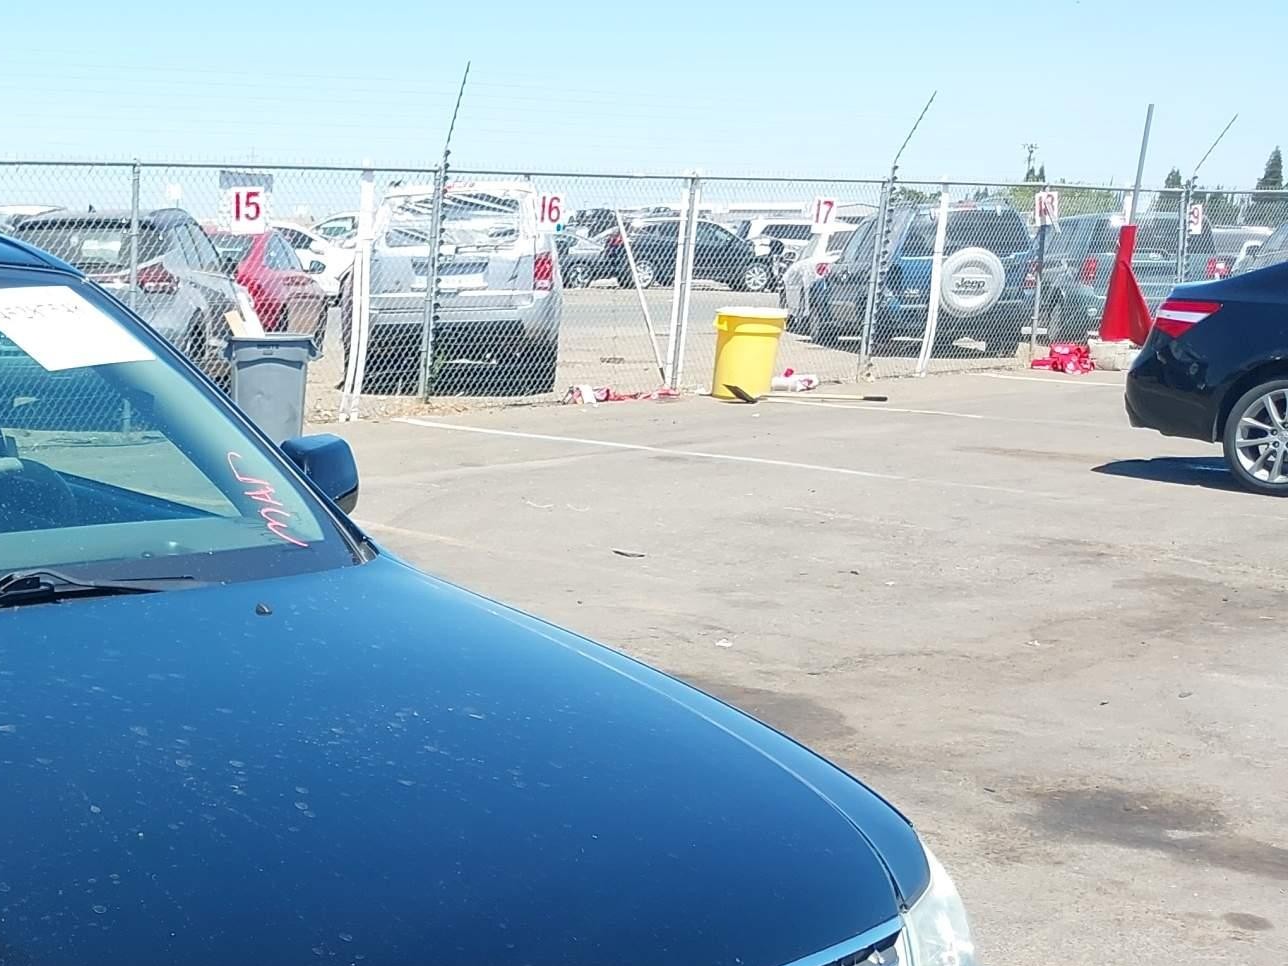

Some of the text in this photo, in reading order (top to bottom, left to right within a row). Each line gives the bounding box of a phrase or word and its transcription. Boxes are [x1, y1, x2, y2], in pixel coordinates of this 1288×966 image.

[234, 191, 261, 222] 15
[539, 196, 561, 223] 16
[815, 200, 834, 224] 17
[955, 277, 986, 290] Jeep
